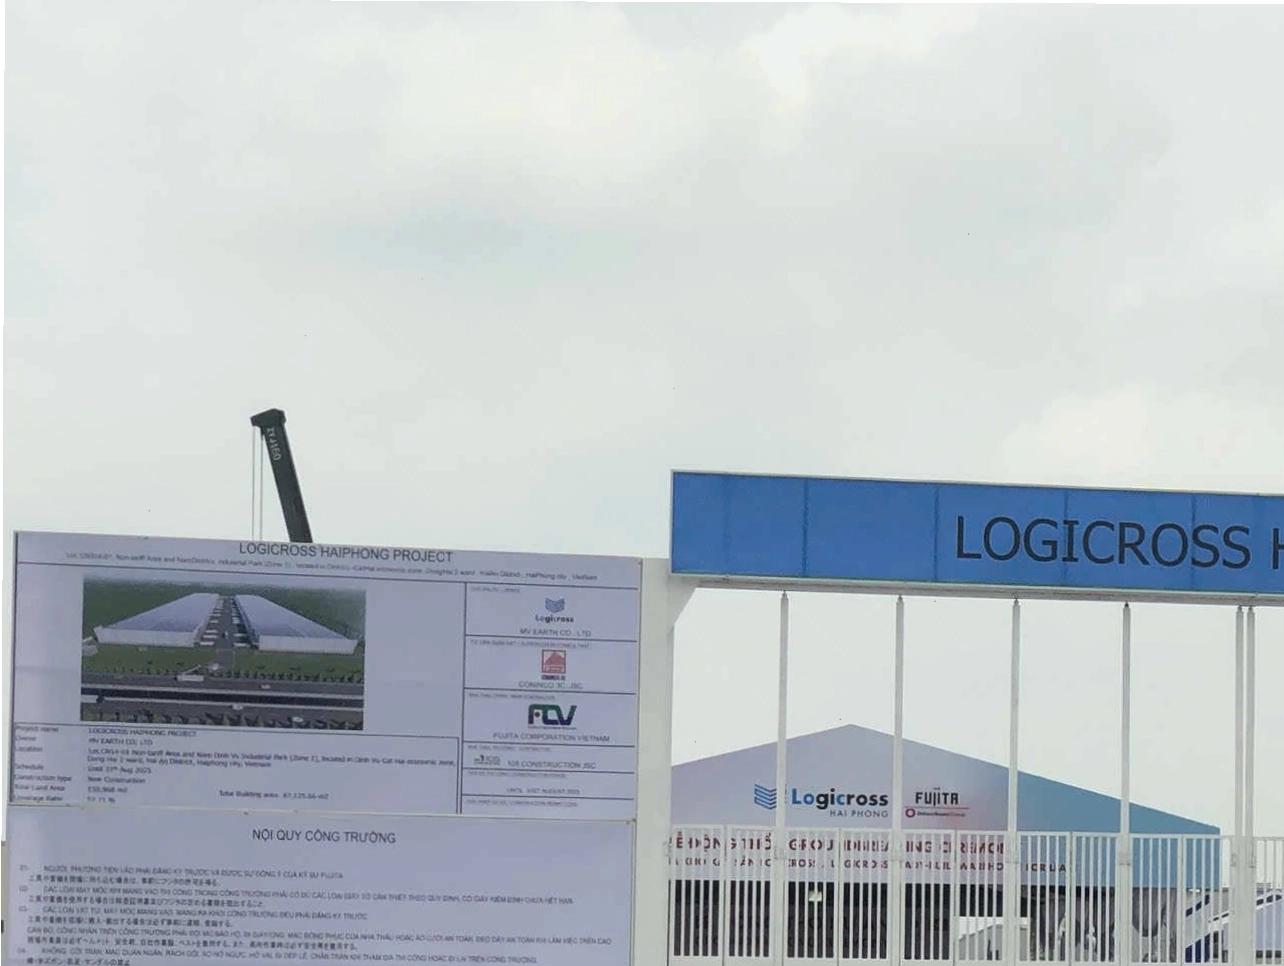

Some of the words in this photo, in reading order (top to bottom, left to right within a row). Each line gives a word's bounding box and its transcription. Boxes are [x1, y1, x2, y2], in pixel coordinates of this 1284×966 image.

[239, 543, 316, 557] LOGICROSS
[320, 546, 389, 560] HAIPHONG
[393, 549, 453, 562] PROJECT
[956, 515, 1251, 570] LOGICROSS
[791, 787, 889, 809] Logicross
[915, 786, 959, 807] FUJITA
[830, 809, 847, 818] HAI
[851, 810, 889, 818] PHONG
[252, 828, 273, 842] NỘI
[276, 830, 301, 842] QUY
[304, 830, 340, 842] CÔNG
